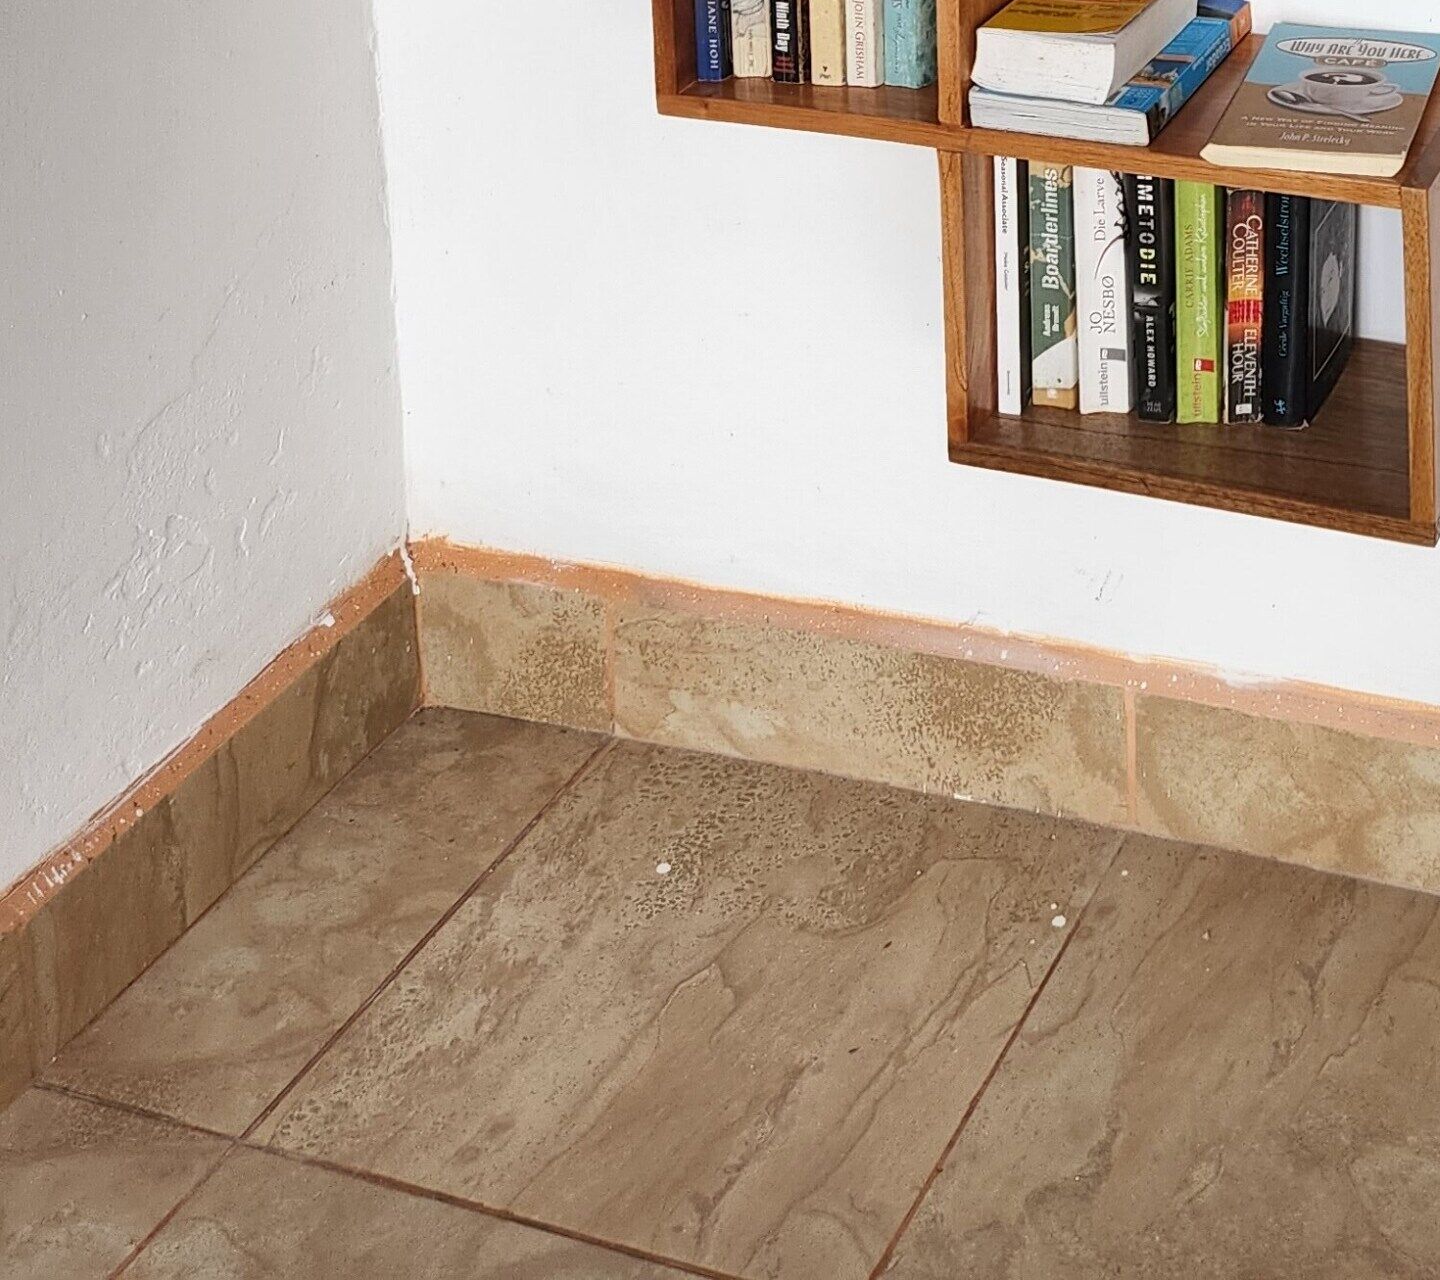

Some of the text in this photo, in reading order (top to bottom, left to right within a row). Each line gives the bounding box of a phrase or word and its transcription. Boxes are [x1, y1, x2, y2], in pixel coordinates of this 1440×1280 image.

[775, 32, 790, 53] Day
[776, 1, 789, 29] Ninth
[851, 0, 866, 80] JOHN GRISHAM
[708, 38, 719, 70] HOH
[1290, 40, 1425, 60] WHY ARE YOU HERE
[1279, 131, 1301, 141] John
[1000, 157, 1010, 234] Seasonal Associate
[1093, 177, 1106, 242] Die Larve
[1039, 167, 1061, 290] Boarderlines
[1231, 222, 1250, 290] COULTER
[1245, 214, 1263, 294] CATHERINE
[1185, 224, 1194, 308] CARRIE ADAMS
[1089, 311, 1101, 334] JO
[1101, 275, 1116, 333] NESBØ
[1139, 247, 1158, 388] DIE ALEX HOWARD
[1099, 361, 1110, 407] ullstein
[1231, 341, 1244, 384] HOUR
[1244, 328, 1256, 396] ELEVENTH
